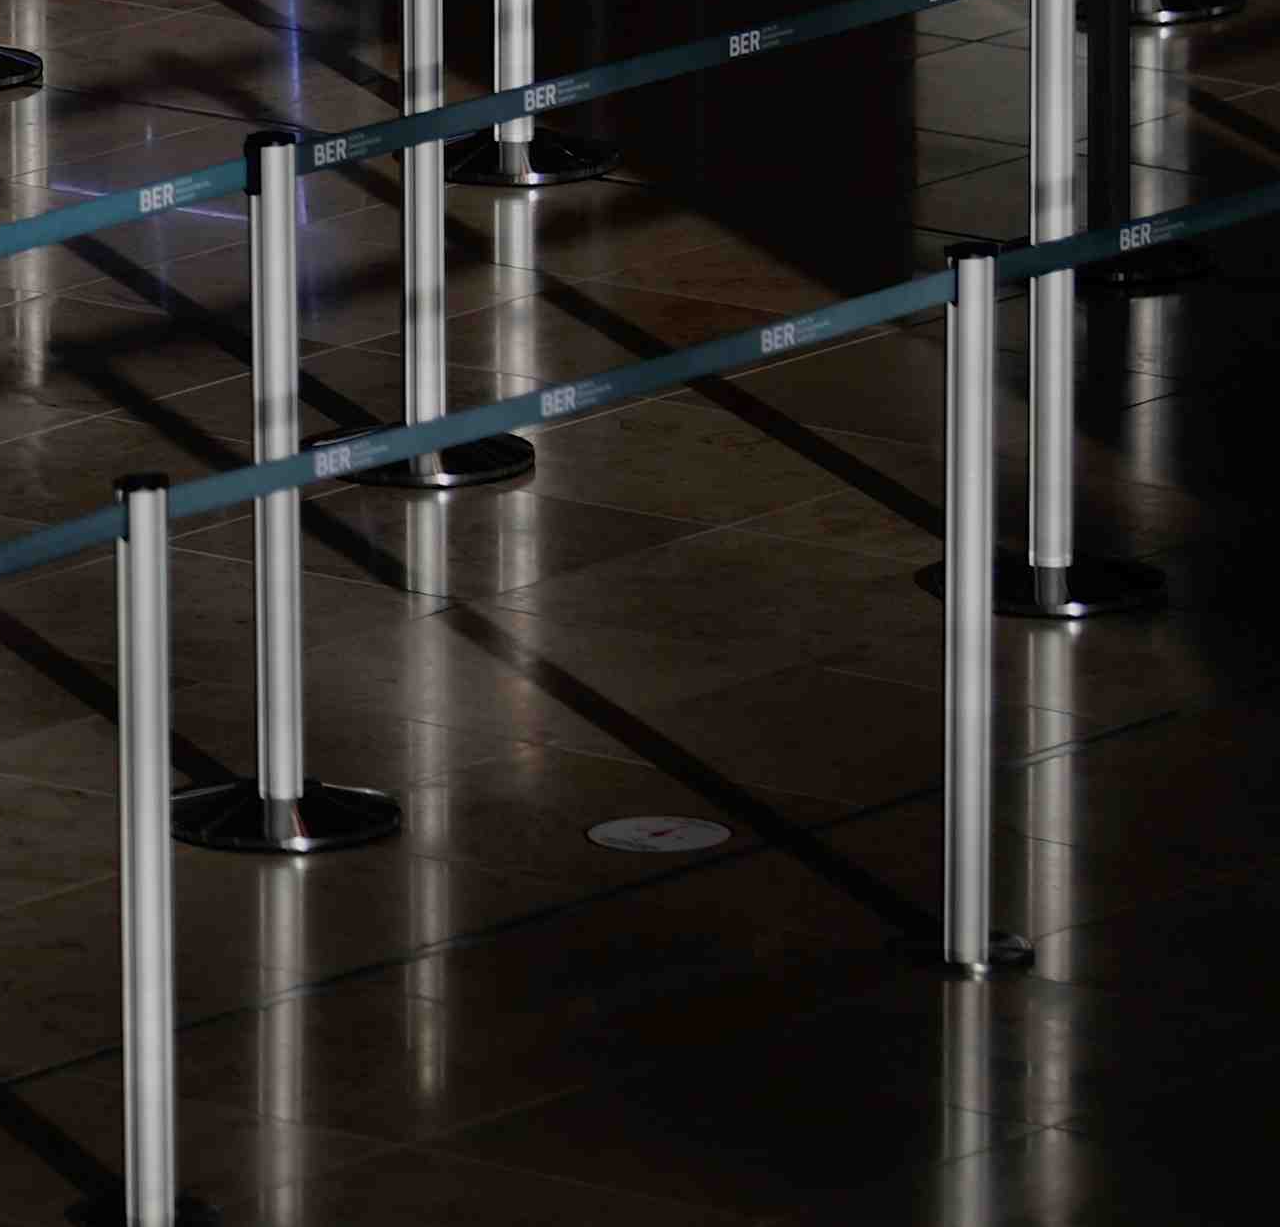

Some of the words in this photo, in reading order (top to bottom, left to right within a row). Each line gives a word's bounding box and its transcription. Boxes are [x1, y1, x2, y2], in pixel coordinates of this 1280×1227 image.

[729, 31, 760, 56] BER
[524, 85, 556, 111] BER
[313, 140, 347, 167] BER
[140, 183, 174, 211] BER
[1120, 224, 1151, 250] BER
[761, 325, 795, 352] BER
[541, 386, 575, 414] BER
[314, 446, 350, 478] BER
